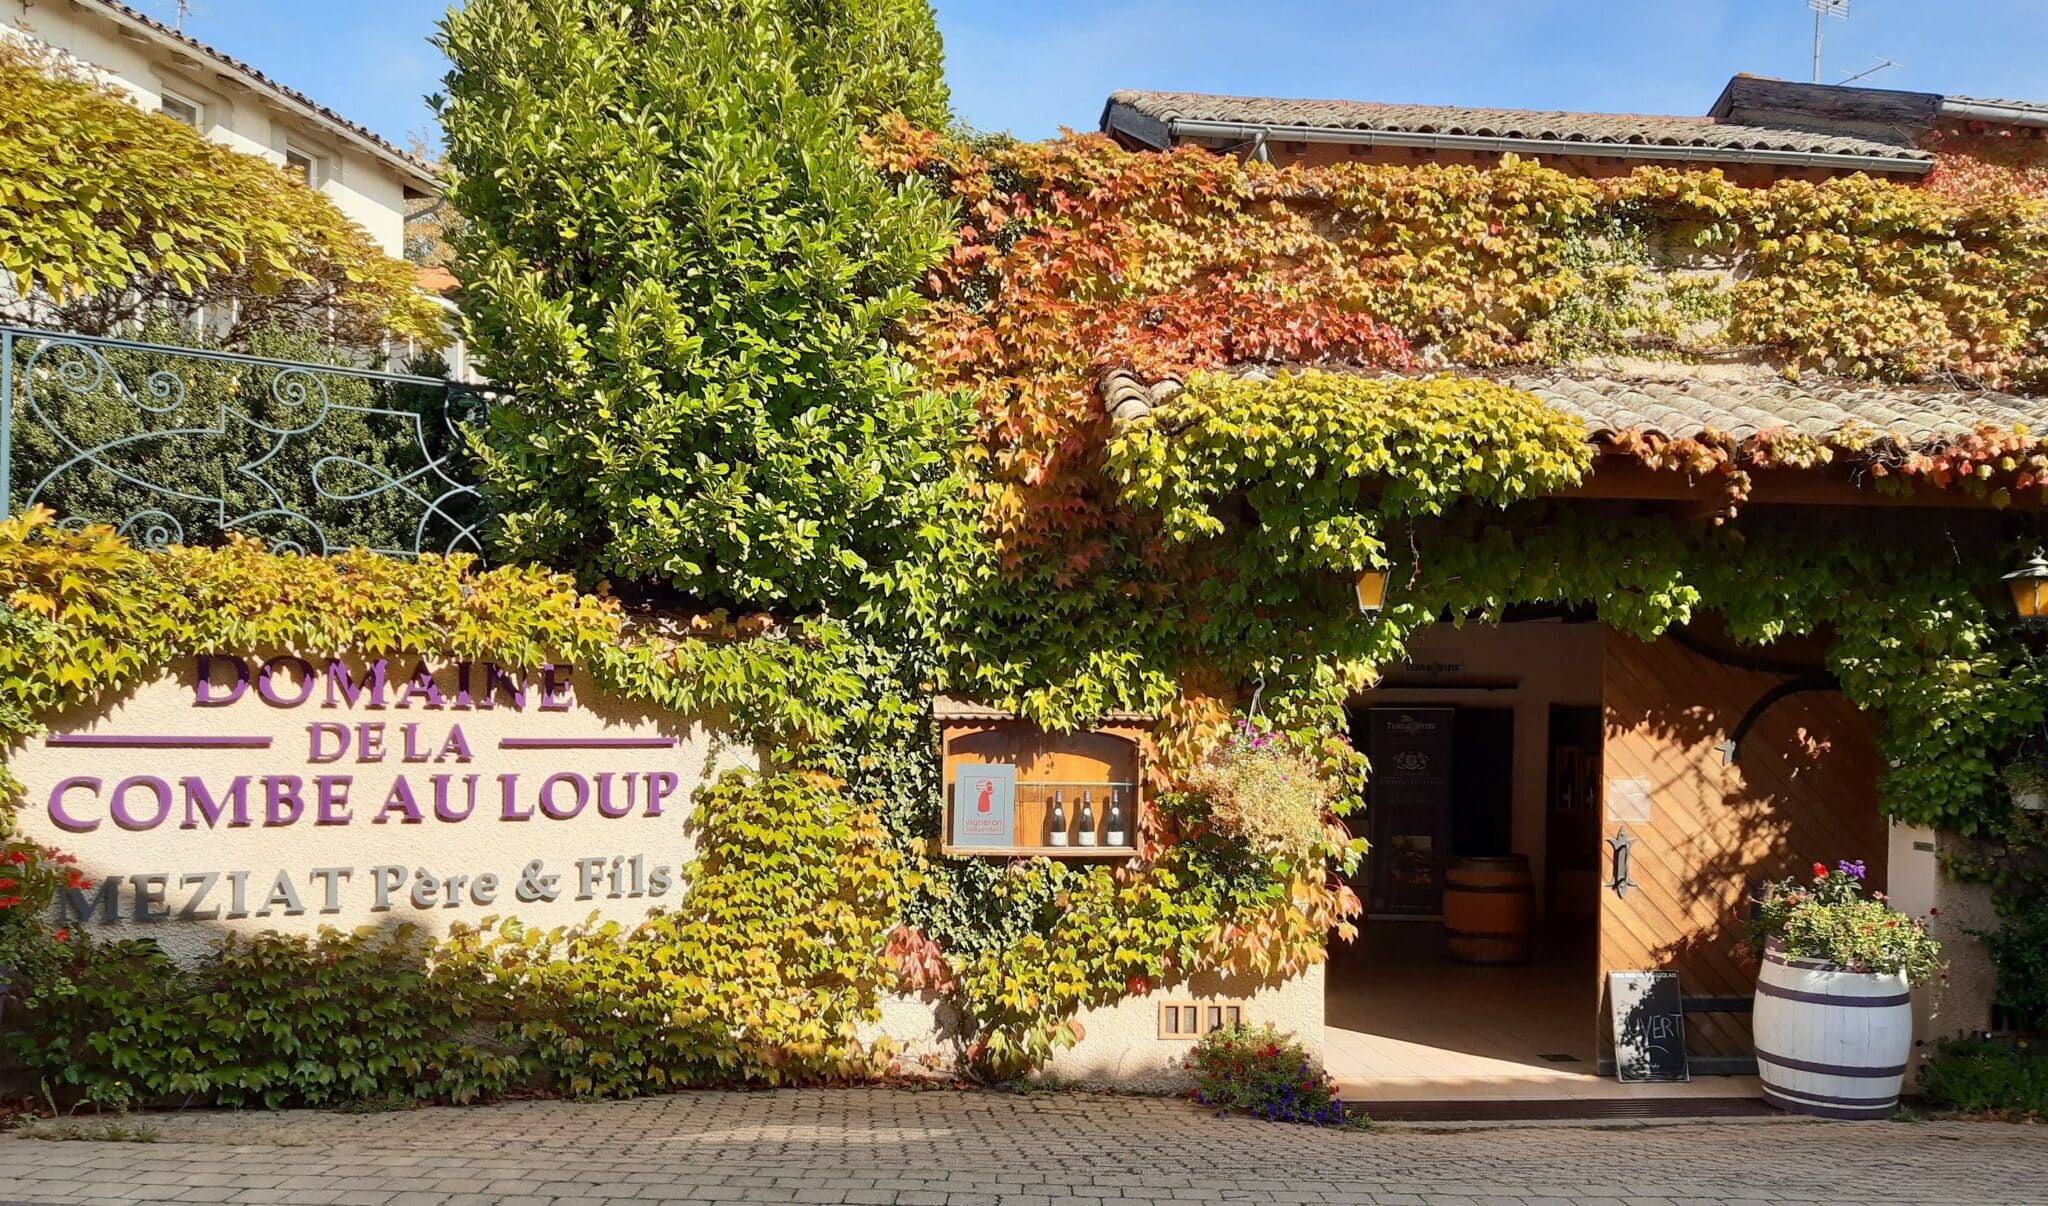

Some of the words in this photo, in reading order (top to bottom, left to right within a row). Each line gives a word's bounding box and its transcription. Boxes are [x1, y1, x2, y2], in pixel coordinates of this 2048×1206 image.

[194, 654, 574, 711] DOMAINE
[307, 721, 386, 763] DE
[401, 722, 473, 763] LA
[48, 775, 354, 832] COMBE
[371, 773, 480, 824] AU
[497, 772, 679, 821] LOUP
[965, 818, 1003, 827] vigneron
[57, 867, 354, 924] MEZIAT
[370, 865, 500, 912] Père
[515, 859, 562, 903] &
[575, 853, 673, 900] Fils
[1623, 1012, 1683, 1040] UVERT
